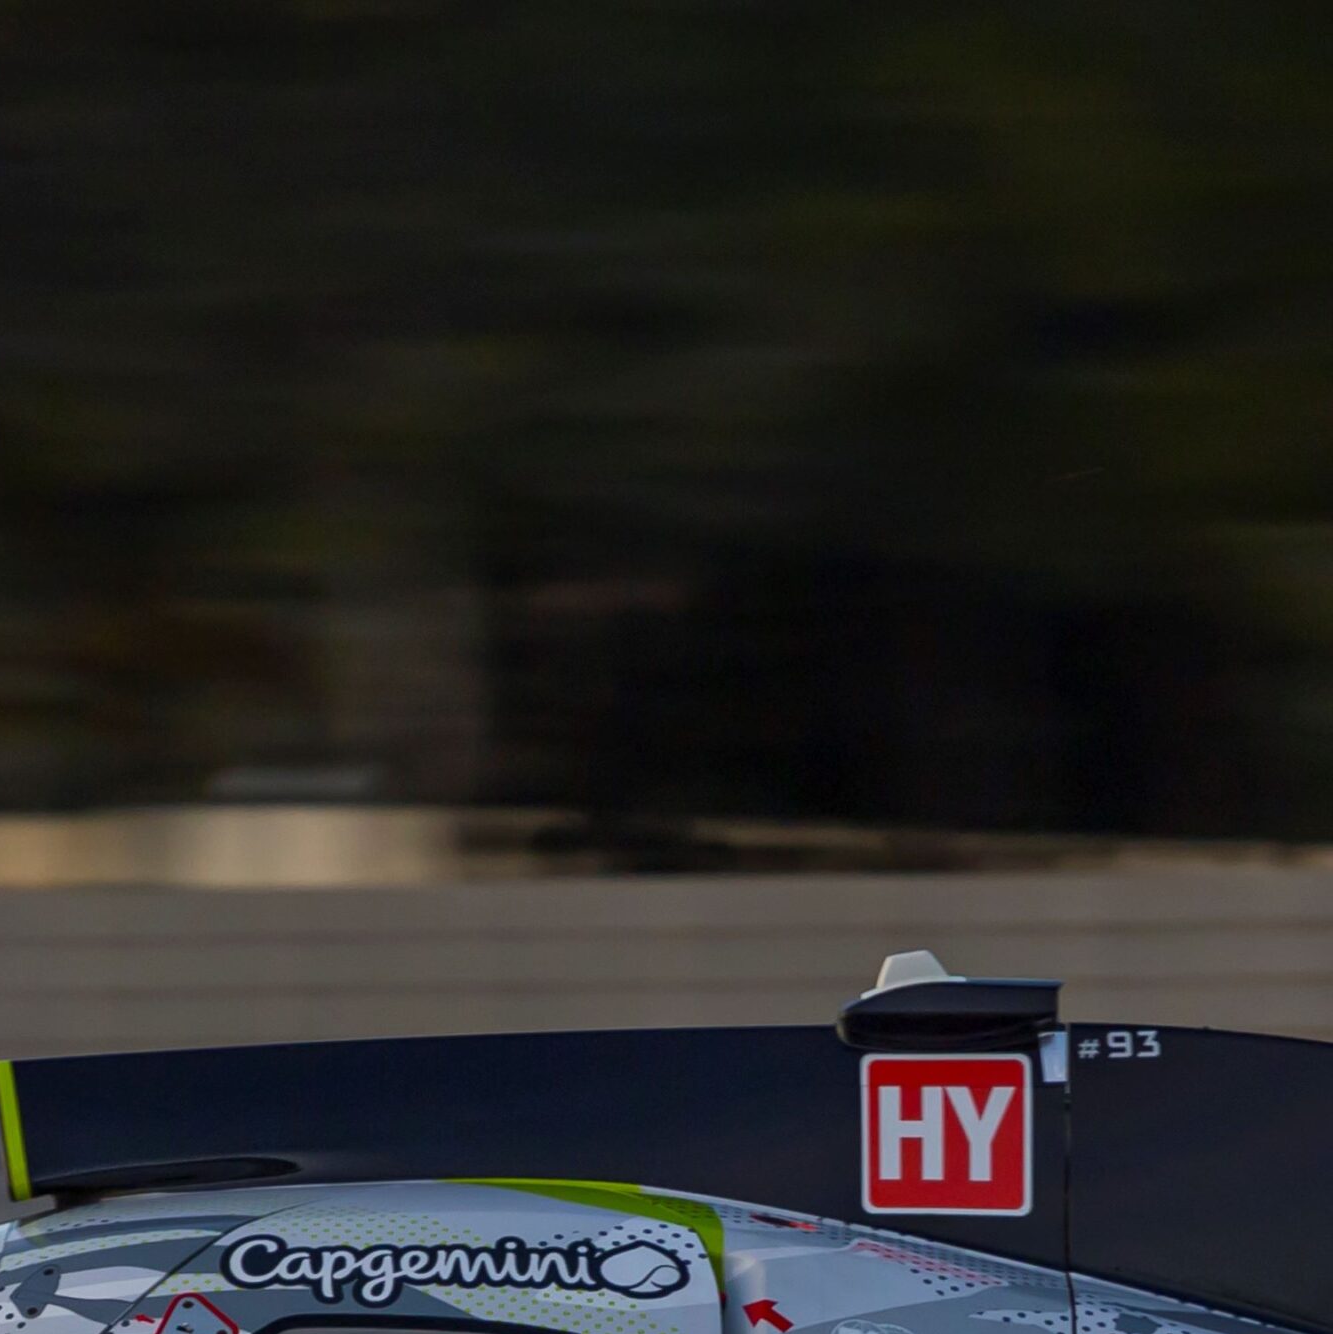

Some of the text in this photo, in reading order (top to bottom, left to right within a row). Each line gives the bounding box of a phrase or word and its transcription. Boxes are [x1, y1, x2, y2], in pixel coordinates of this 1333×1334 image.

[1077, 1030, 1162, 1058] #93
[878, 1086, 1016, 1181] HY
[228, 1238, 598, 1302] Capgemini
